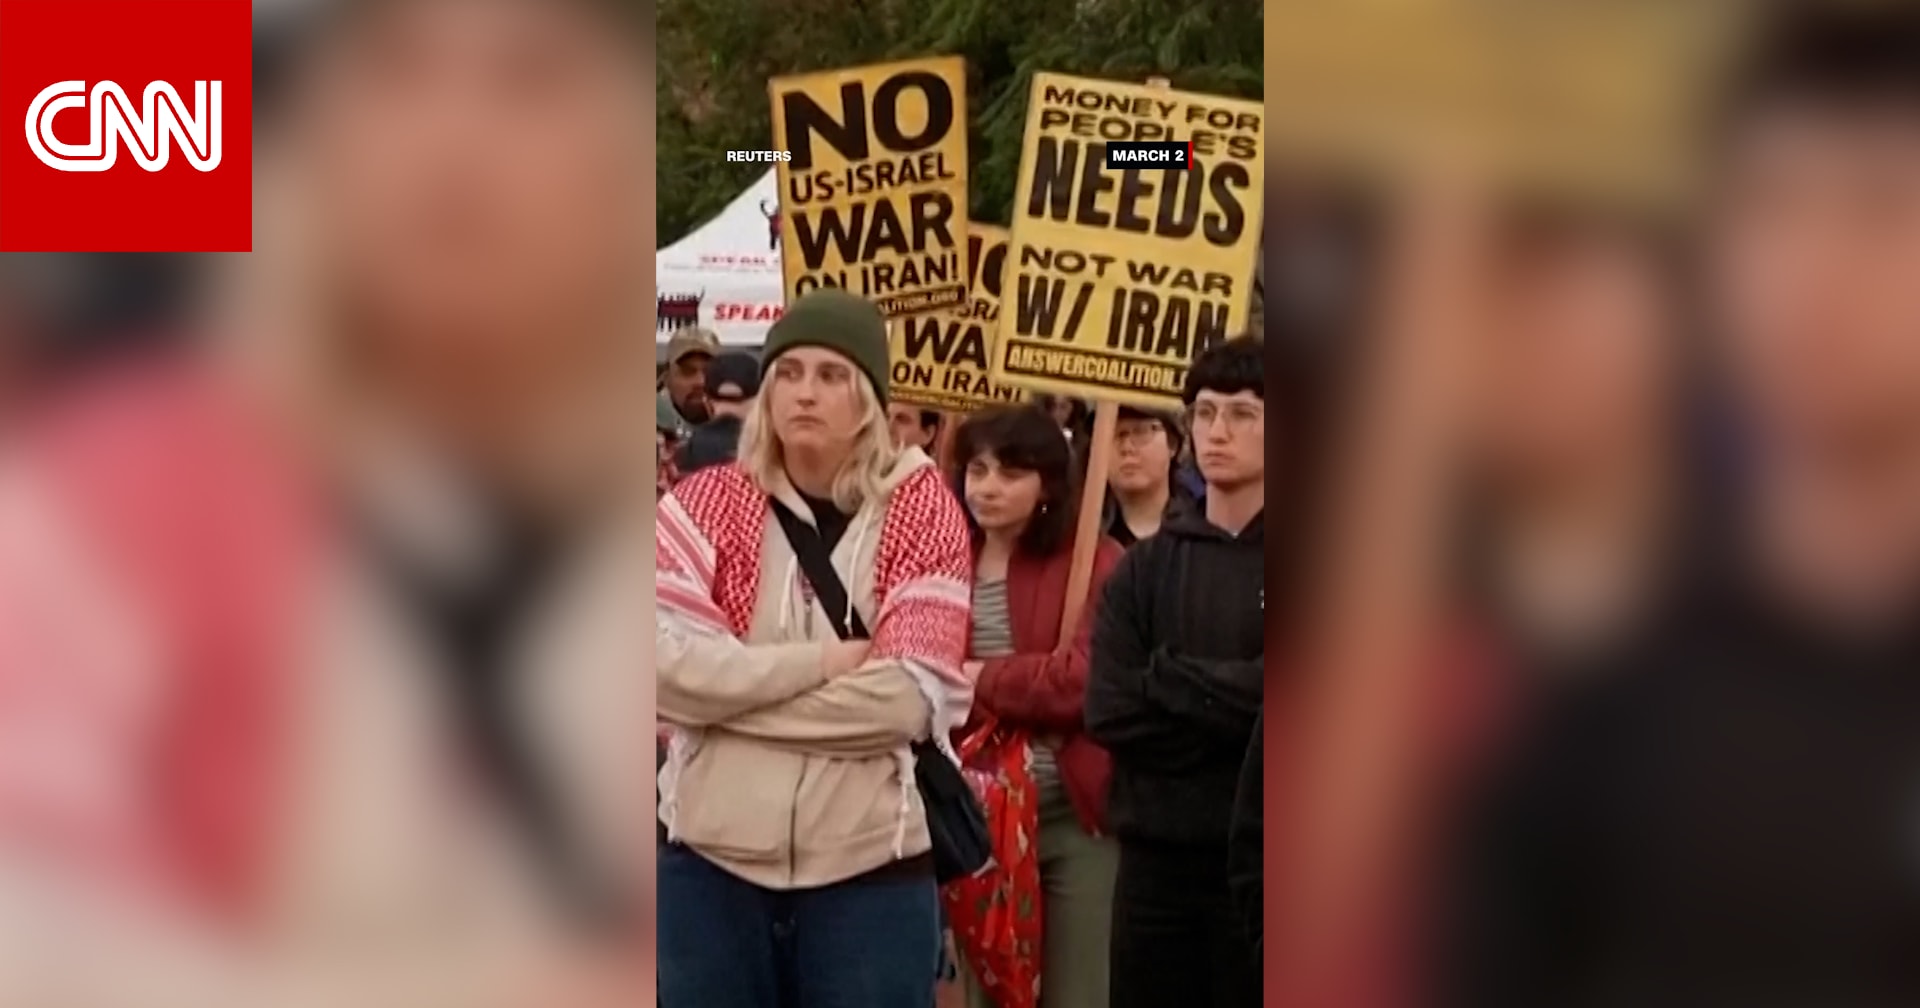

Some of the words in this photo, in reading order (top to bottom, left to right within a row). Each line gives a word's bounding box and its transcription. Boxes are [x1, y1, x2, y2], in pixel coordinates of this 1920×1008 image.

[781, 71, 953, 172] NO
[1040, 109, 1257, 159] PEOPLE'S
[1045, 86, 1176, 118] MONEY
[1185, 105, 1260, 132] FOR
[789, 153, 954, 205] US-ISRAEL
[1028, 136, 1250, 247] NEEDS
[791, 190, 955, 270] WAR
[862, 253, 958, 296] IRAN!
[1020, 245, 1116, 278] NOT
[1126, 260, 1234, 297] WAR
[1016, 273, 1095, 342] W/
[1106, 286, 1230, 359] IRAN
[905, 317, 988, 371] WA
[893, 362, 933, 387] ON
